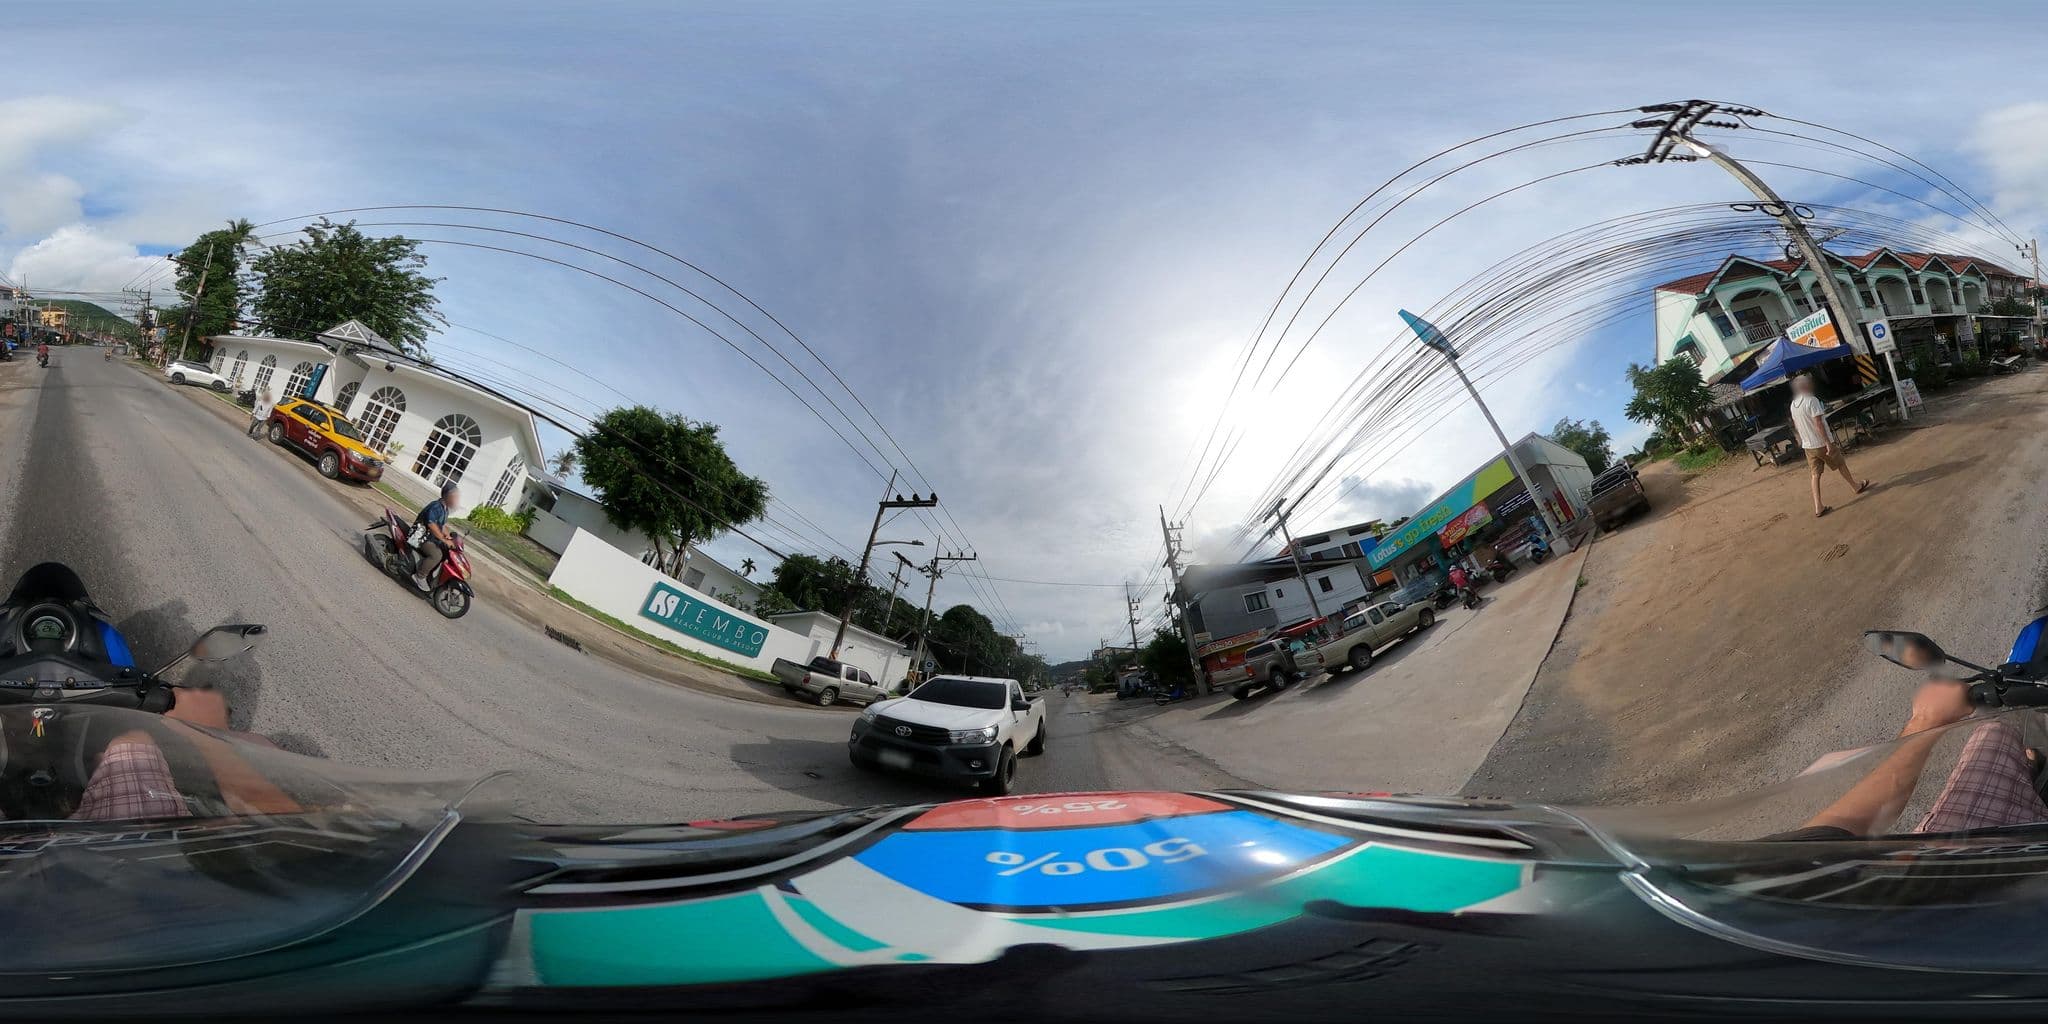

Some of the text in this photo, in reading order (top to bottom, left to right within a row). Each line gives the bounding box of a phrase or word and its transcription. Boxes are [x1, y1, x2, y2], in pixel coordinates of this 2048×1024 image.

[1373, 538, 1404, 563] Lotus's
[1404, 530, 1420, 545] go
[674, 618, 698, 632] BEACH
[702, 629, 722, 640] CLUB
[732, 640, 758, 652] RESORT
[681, 600, 764, 645] TEMBO
[1013, 799, 1130, 815] 25%
[985, 837, 1208, 876] 50%
